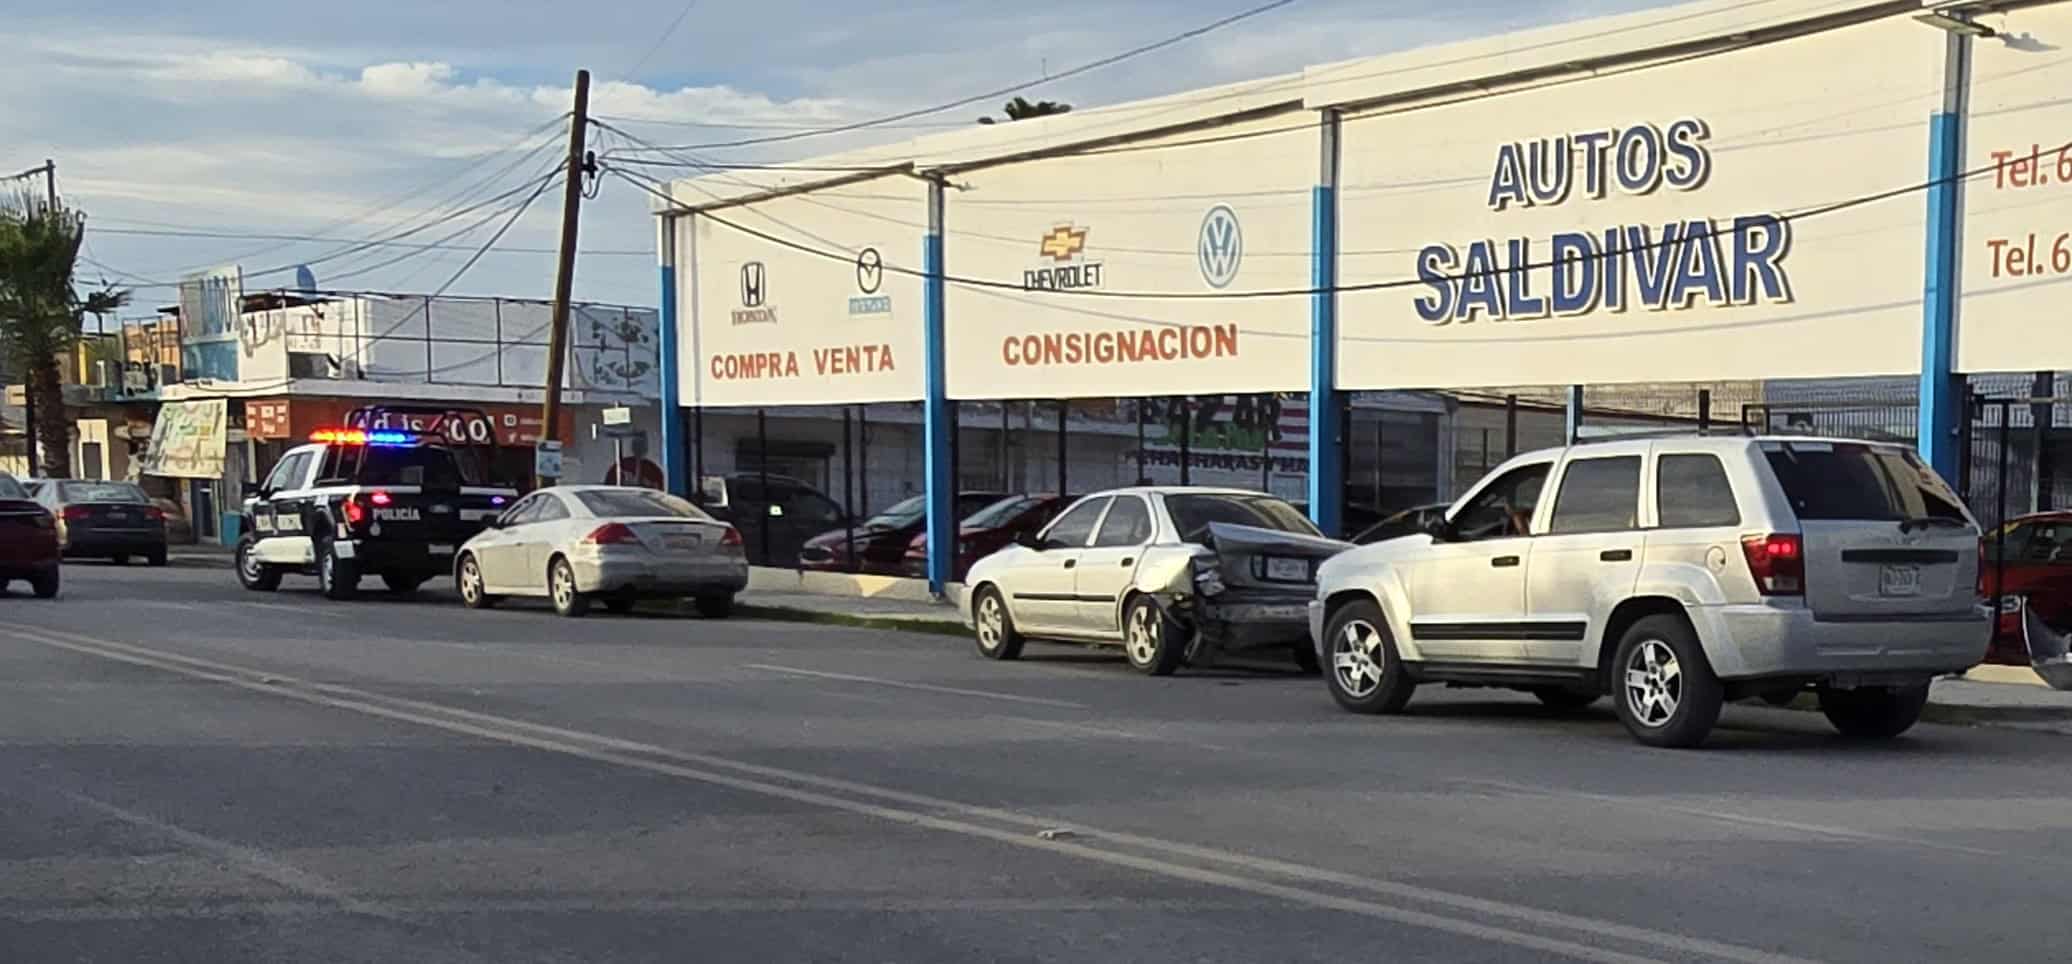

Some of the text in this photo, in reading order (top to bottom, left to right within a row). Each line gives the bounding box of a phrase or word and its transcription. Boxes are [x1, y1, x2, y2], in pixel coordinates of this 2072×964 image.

[1488, 117, 1711, 211] AUTOS
[1991, 143, 2048, 189] Tel.
[1024, 263, 1102, 290] CHEVROLET
[1413, 213, 1795, 325] SALDIVAR
[1987, 233, 2044, 277] Tel.
[731, 308, 777, 326] HONDA
[711, 344, 895, 379] COMPRA VENTA
[1003, 323, 1238, 366] CONSIGNACION
[373, 506, 421, 521] POLICÍA
